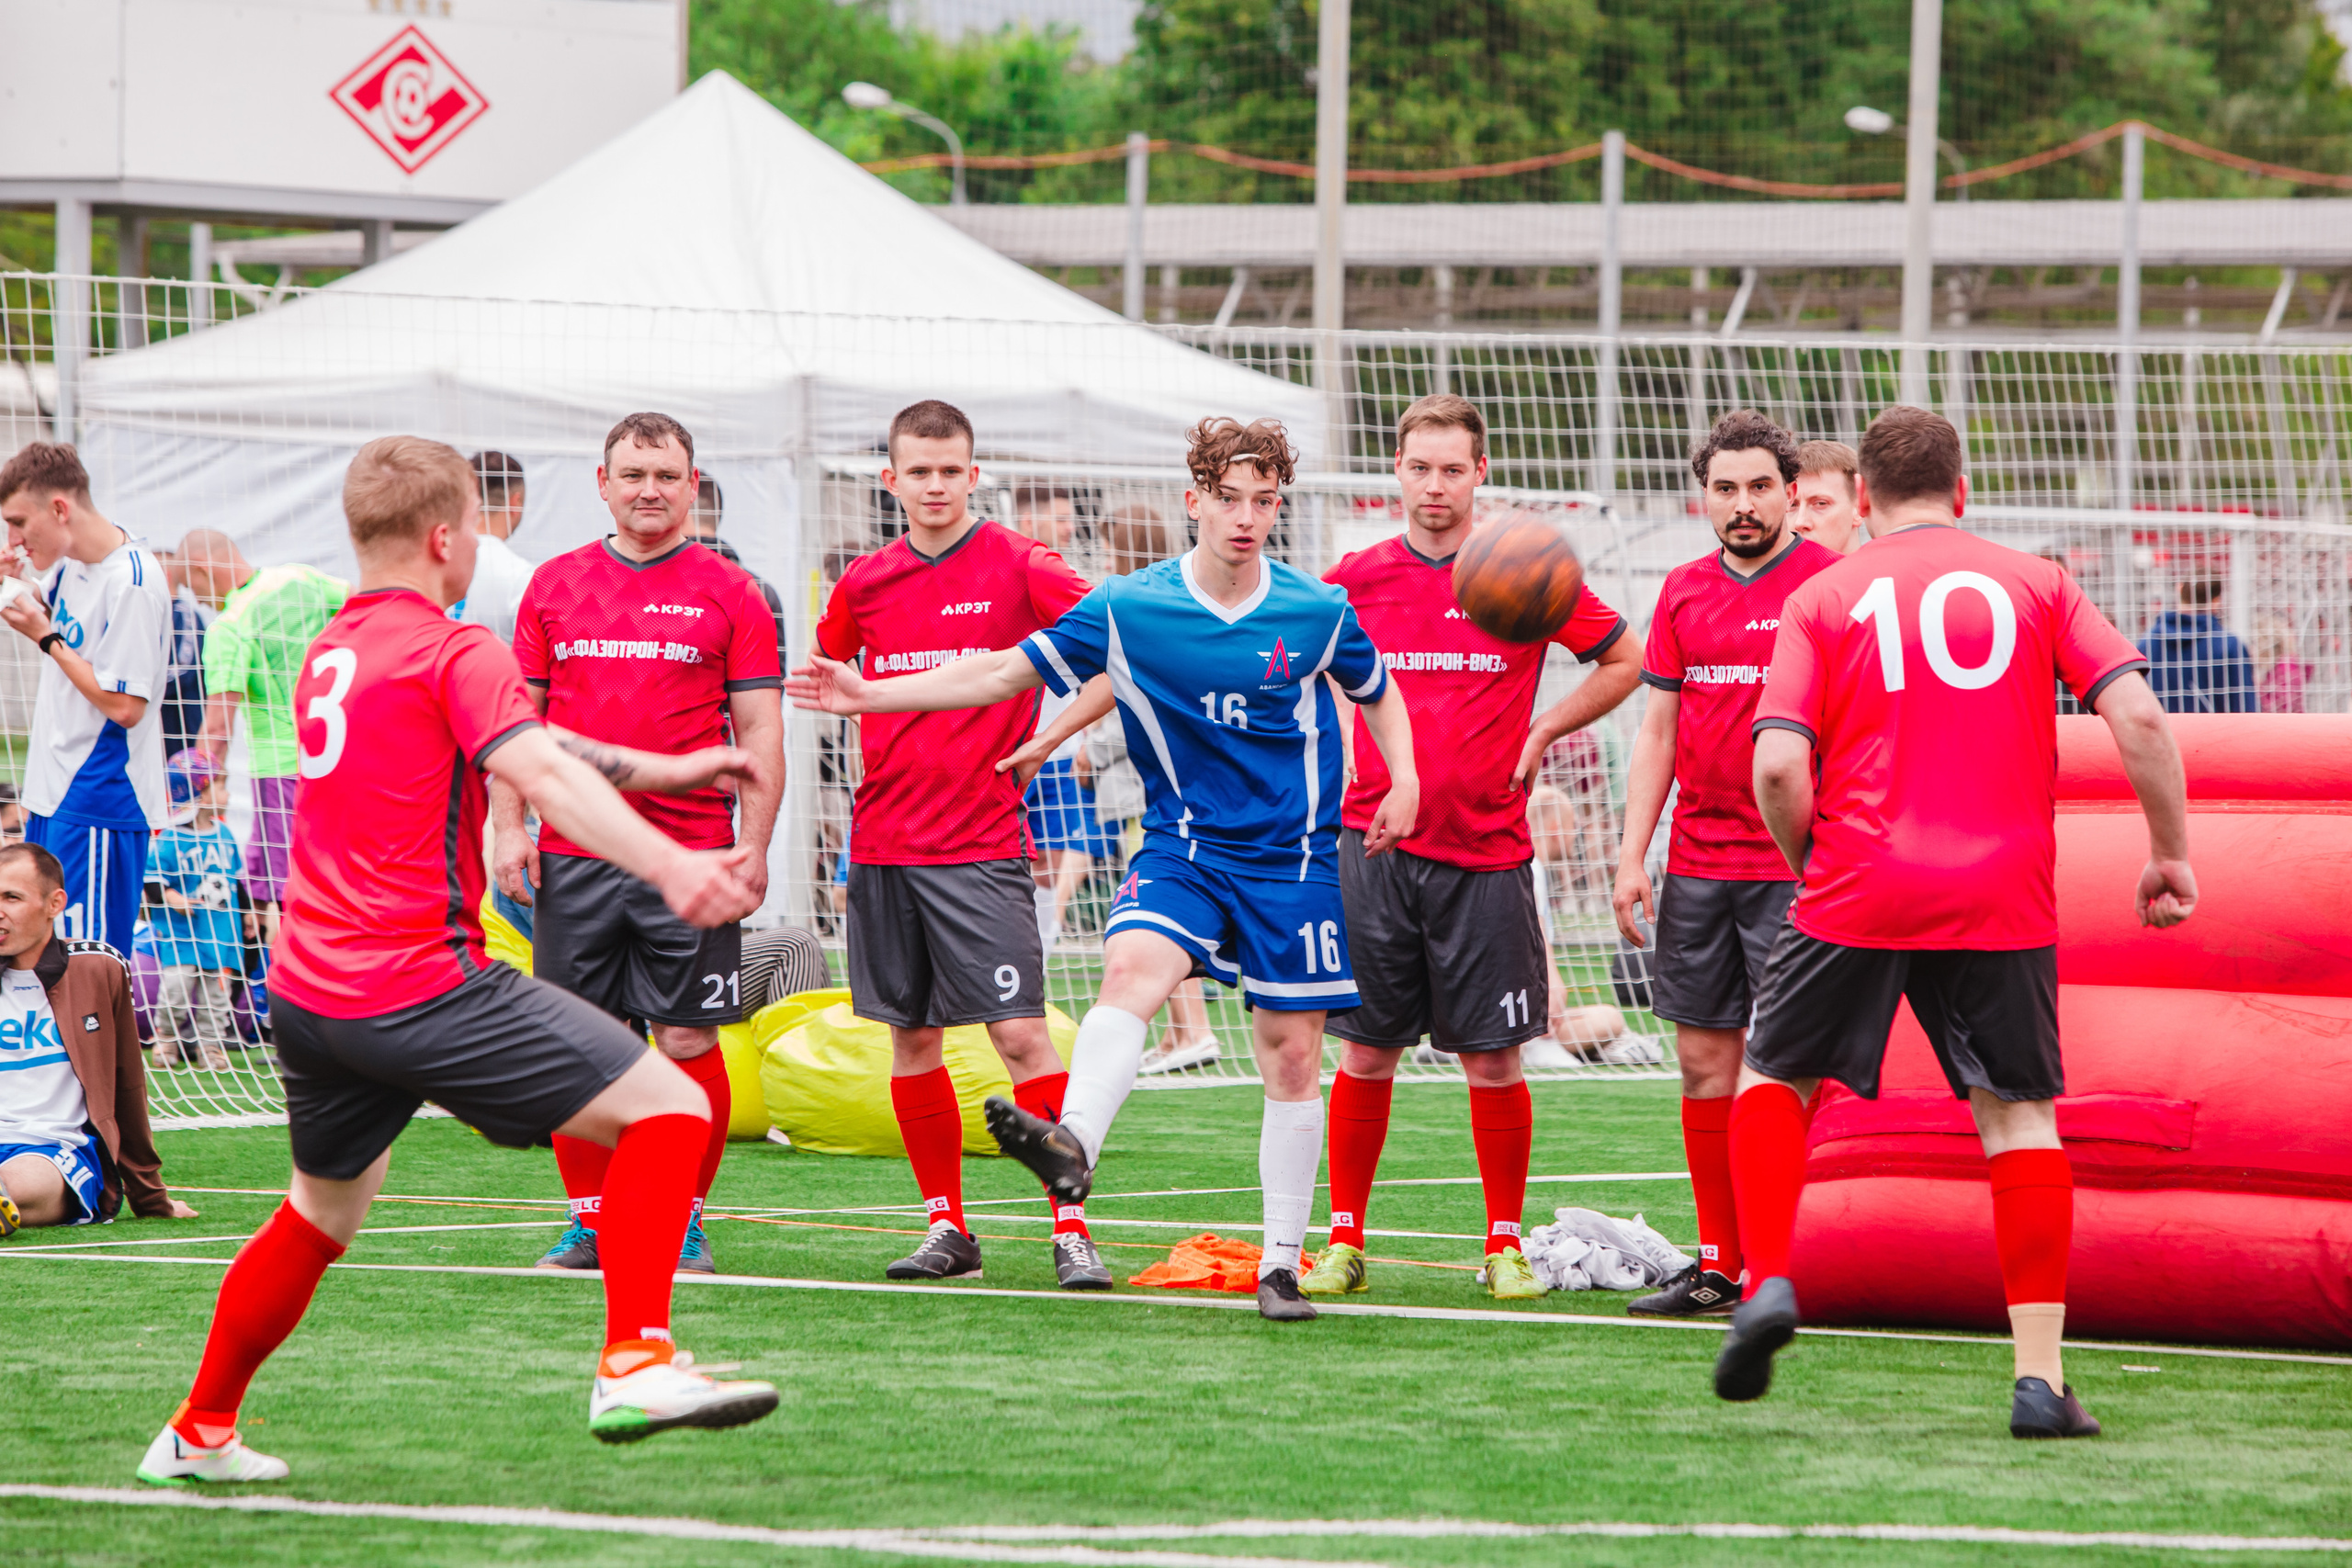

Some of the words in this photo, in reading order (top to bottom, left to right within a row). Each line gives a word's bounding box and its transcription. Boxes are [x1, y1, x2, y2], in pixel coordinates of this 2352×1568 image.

[662, 604, 704, 618] КРЭТ
[956, 602, 991, 615] КРЭТ
[1760, 619, 1780, 631] КР
[1849, 570, 2017, 693] 10
[300, 648, 357, 779] 3
[1200, 692, 1248, 729] 16
[1298, 919, 1341, 974] 16
[701, 970, 740, 1009] 21
[994, 964, 1021, 1002] 9
[1498, 988, 1530, 1028] 11
